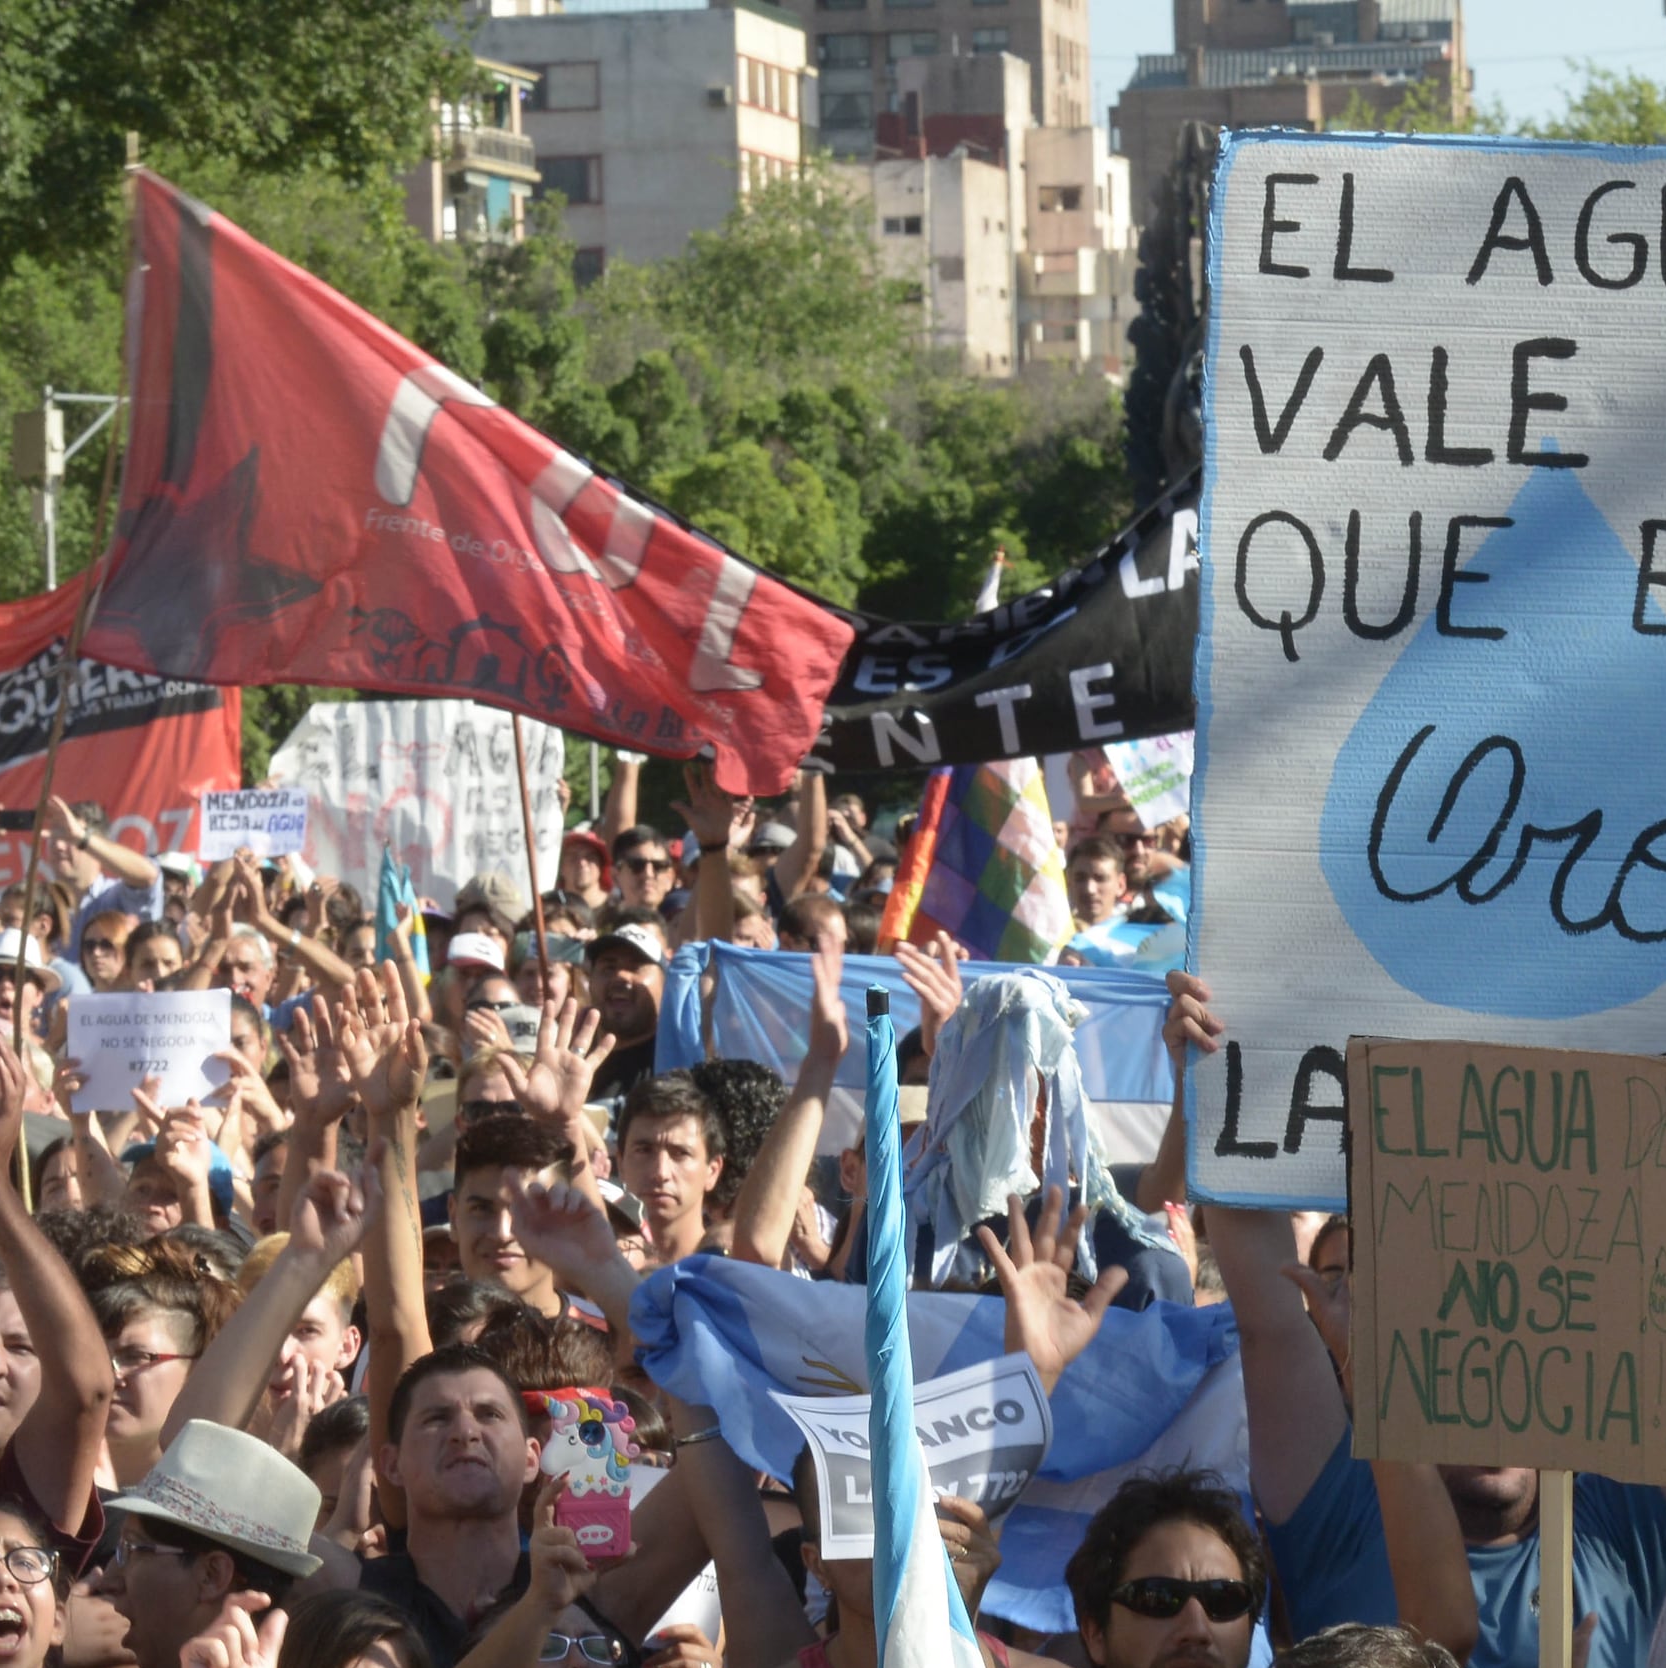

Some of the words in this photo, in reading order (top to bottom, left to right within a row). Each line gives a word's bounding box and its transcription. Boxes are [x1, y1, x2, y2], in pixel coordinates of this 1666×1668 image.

[1259, 172, 1394, 283] EL
[1239, 337, 1589, 467] VALE
[1235, 510, 1515, 661] QUE
[207, 792, 289, 811] MENDOZA
[80, 1015, 94, 1026] EL
[96, 1014, 132, 1026] AGUA
[134, 1013, 150, 1025] DE
[153, 1011, 216, 1025] MENDOZA
[100, 1037, 120, 1049] NO
[123, 1037, 137, 1048] SE
[140, 1035, 196, 1047] NEGOCIA
[1371, 1064, 1445, 1160] EL
[1456, 1063, 1598, 1175] AGUA
[1378, 1174, 1644, 1263] MENDOZA
[1437, 1259, 1521, 1334] NO
[1526, 1267, 1597, 1333] SE
[915, 1399, 1025, 1447] ANCO
